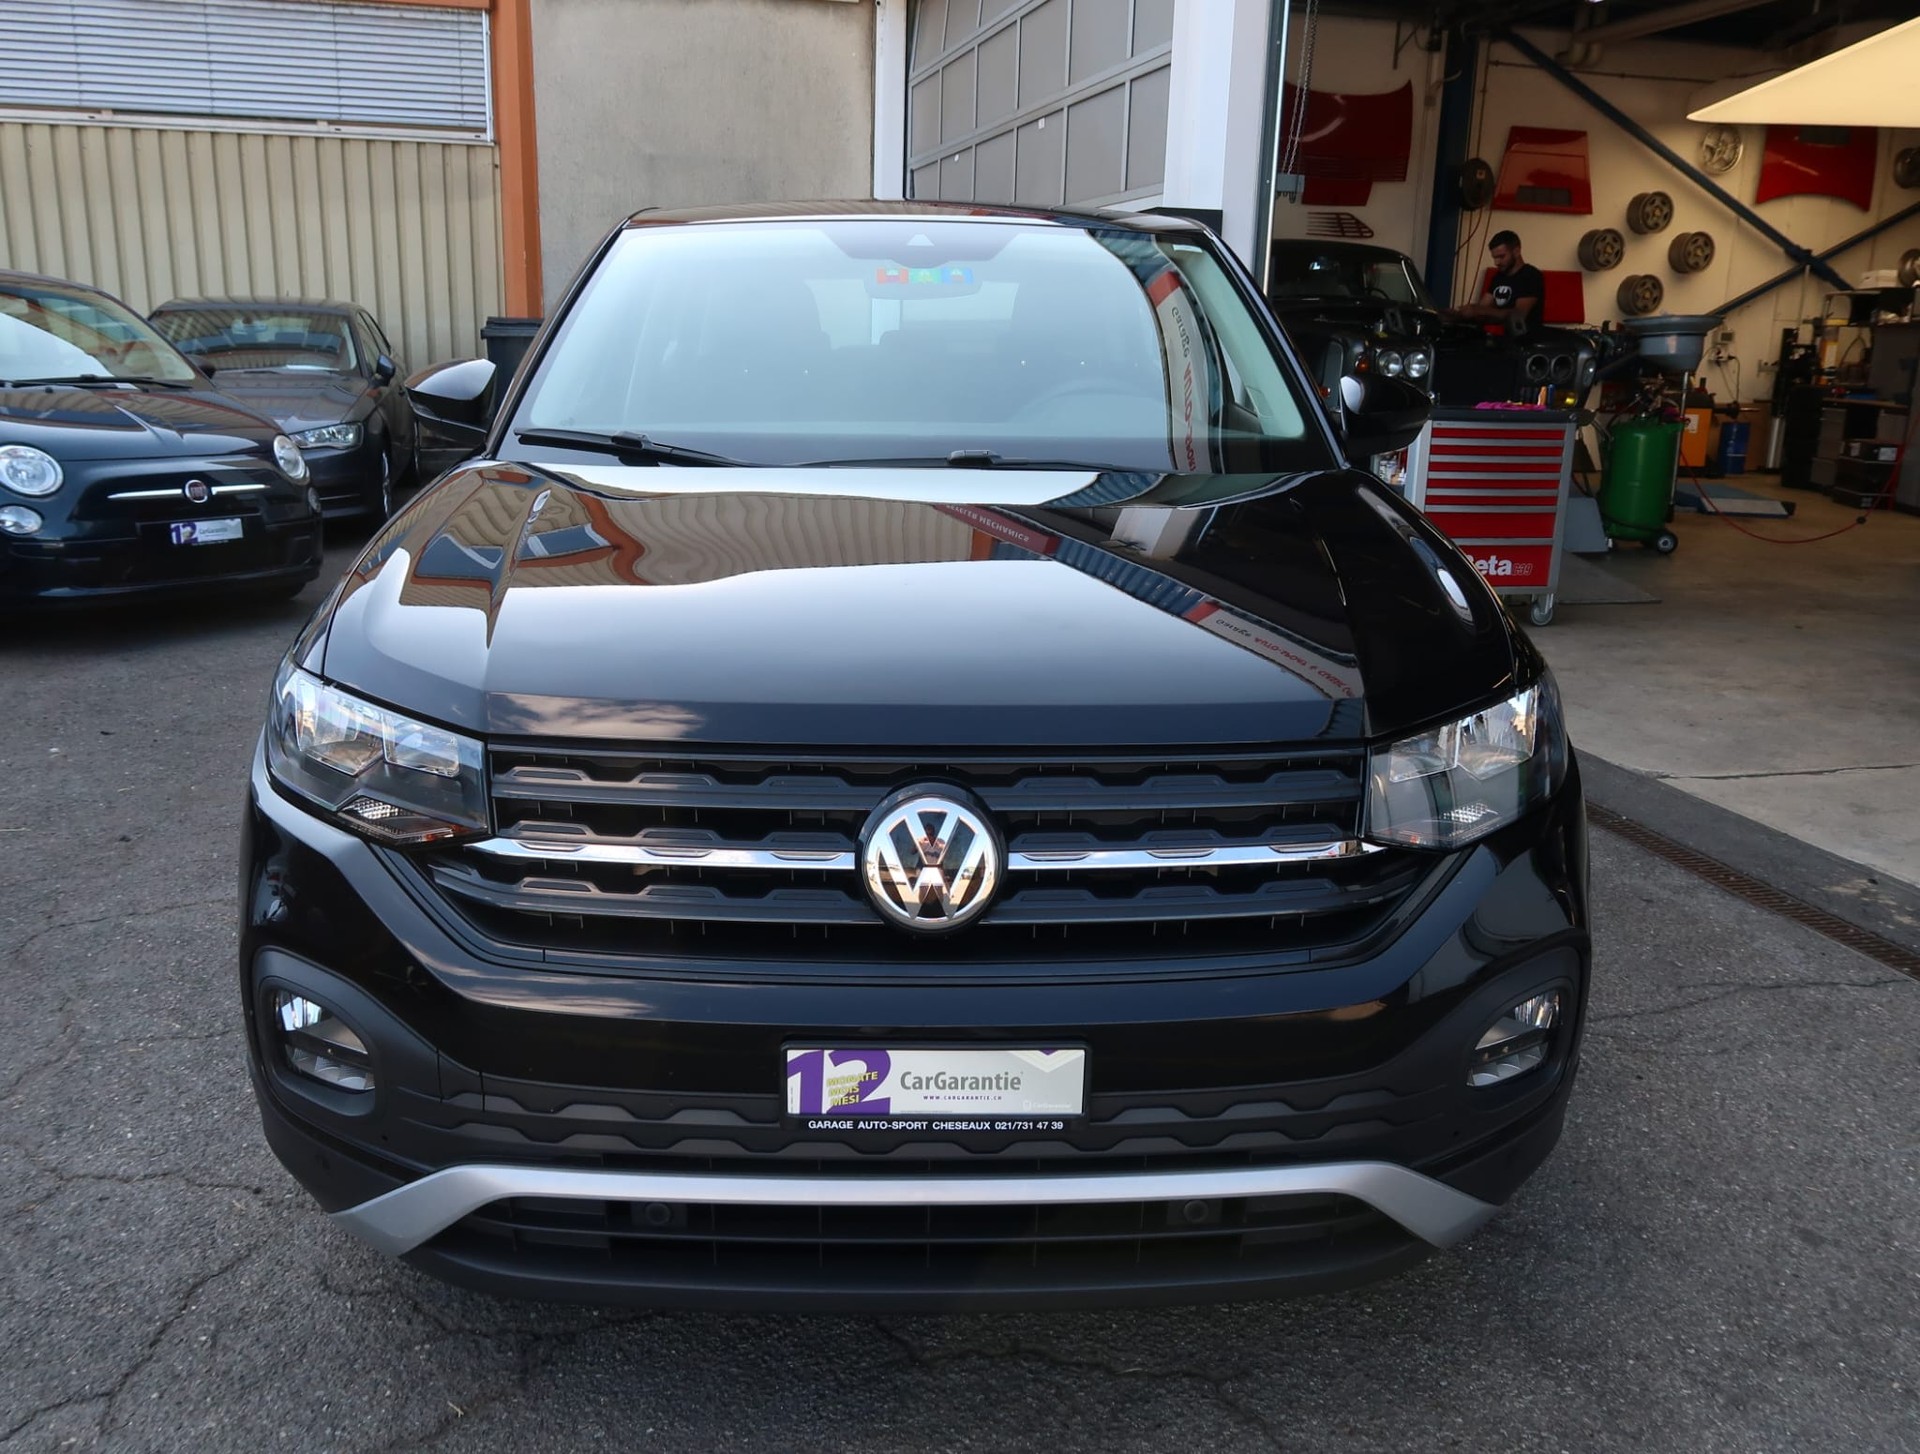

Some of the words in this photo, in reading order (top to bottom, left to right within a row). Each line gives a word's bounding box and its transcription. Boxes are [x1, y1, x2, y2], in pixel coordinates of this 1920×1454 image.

[786, 1049, 892, 1116] 12
[827, 1071, 879, 1086] MONATE
[900, 1071, 1022, 1091] CarGarantie
[828, 1084, 860, 1097] MOIS
[830, 1094, 860, 1107] MESI
[808, 1120, 854, 1130] GARAGE
[857, 1120, 928, 1130] AUTO-SPORT
[932, 1121, 991, 1131] CHESEAUX
[994, 1121, 1034, 1130] 021/731
[1036, 1121, 1050, 1130] 47
[1050, 1121, 1064, 1130] 39
